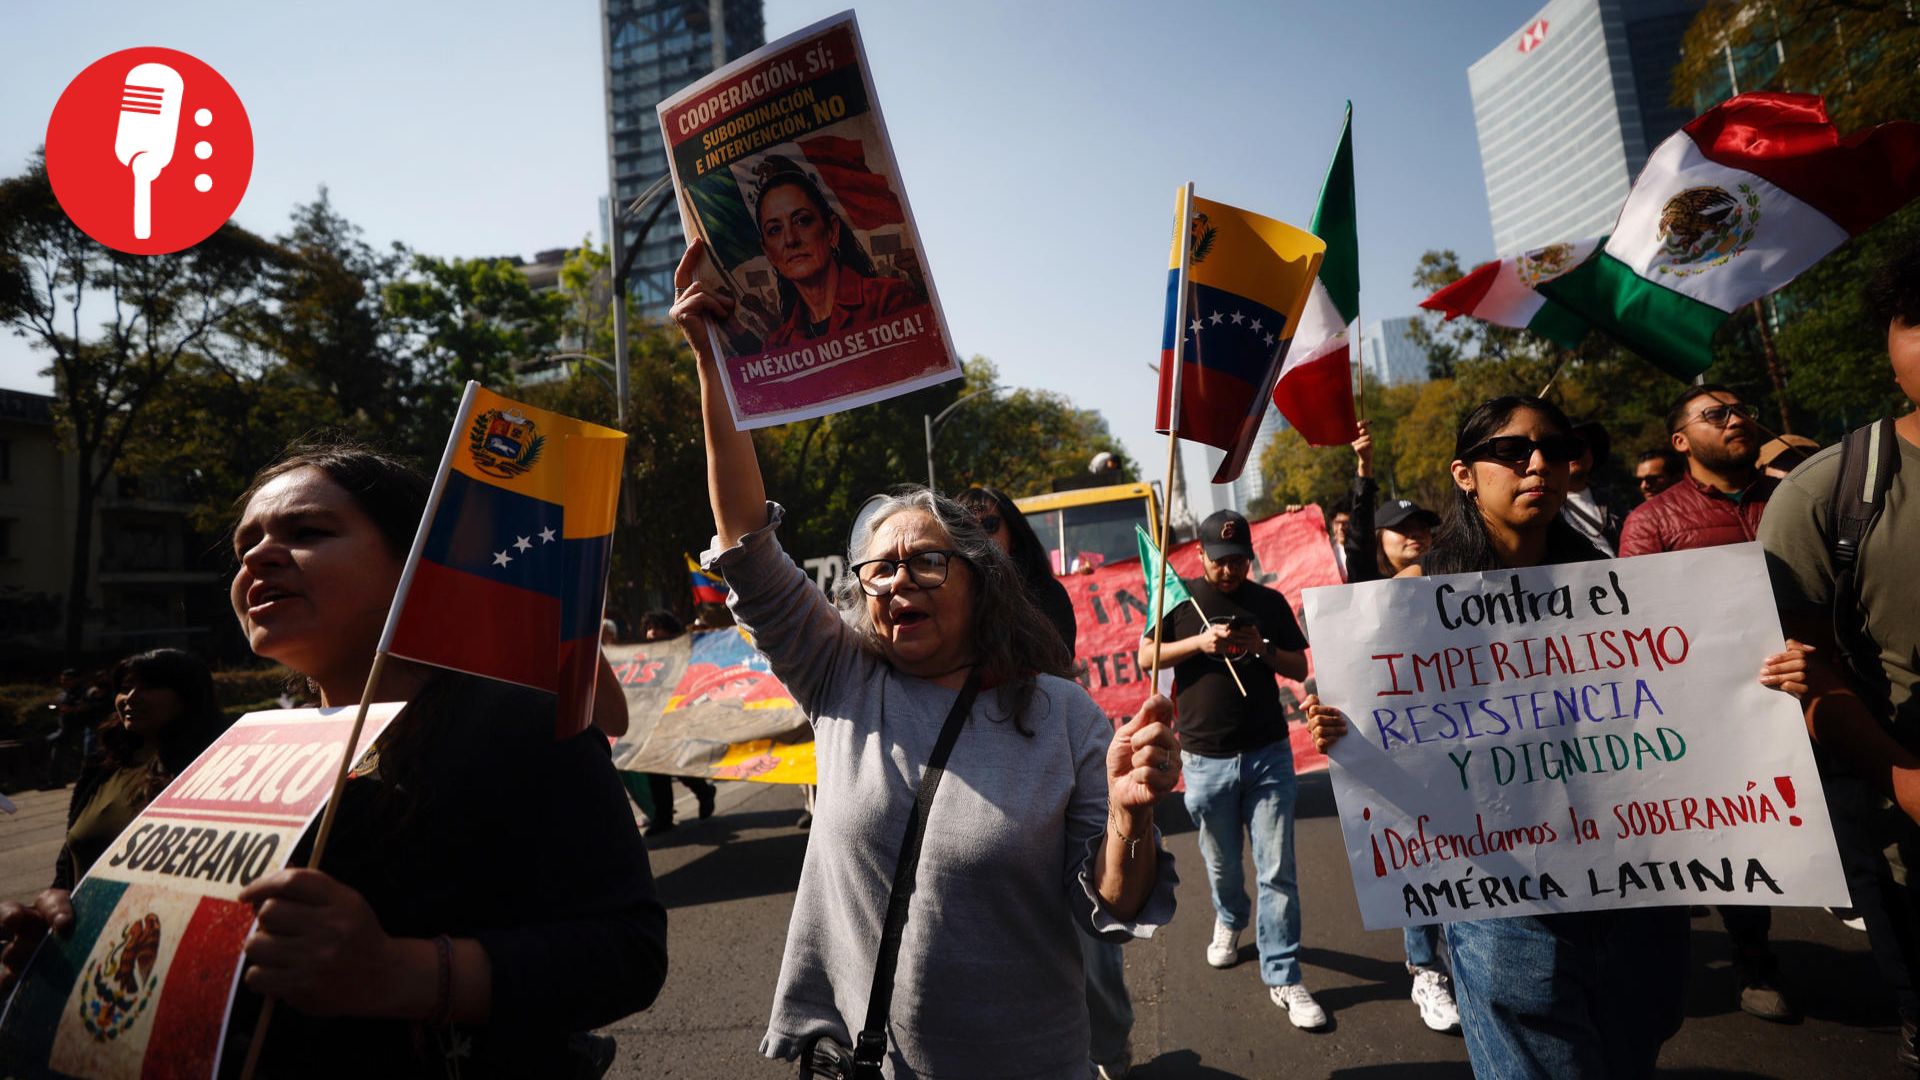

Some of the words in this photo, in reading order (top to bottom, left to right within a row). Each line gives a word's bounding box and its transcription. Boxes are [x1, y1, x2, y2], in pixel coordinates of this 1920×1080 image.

[678, 59, 804, 135] COOPERACIÓN,
[702, 86, 817, 151] SUBORDINACIÓN
[695, 158, 705, 176] E
[705, 112, 813, 171] INTERVENCIÓN,
[812, 94, 847, 126] NO
[740, 350, 815, 384] ¡MÉXICO
[817, 339, 844, 364] NO
[844, 331, 868, 354] SE
[868, 313, 926, 347] TOCA!
[1436, 574, 1574, 631] Contra
[1589, 571, 1630, 616] el
[1371, 625, 1690, 697] IMPERIALISMO
[1372, 678, 1664, 751] RESISTENCIA
[171, 730, 345, 805] MÉXICO
[1448, 749, 1473, 791] Y
[1492, 726, 1687, 786] DIGNIDAD
[109, 823, 280, 887] SOBERANO
[1569, 806, 1600, 845] la
[1402, 866, 1568, 919] AMÉRICA
[1591, 857, 1785, 898] LATINA
